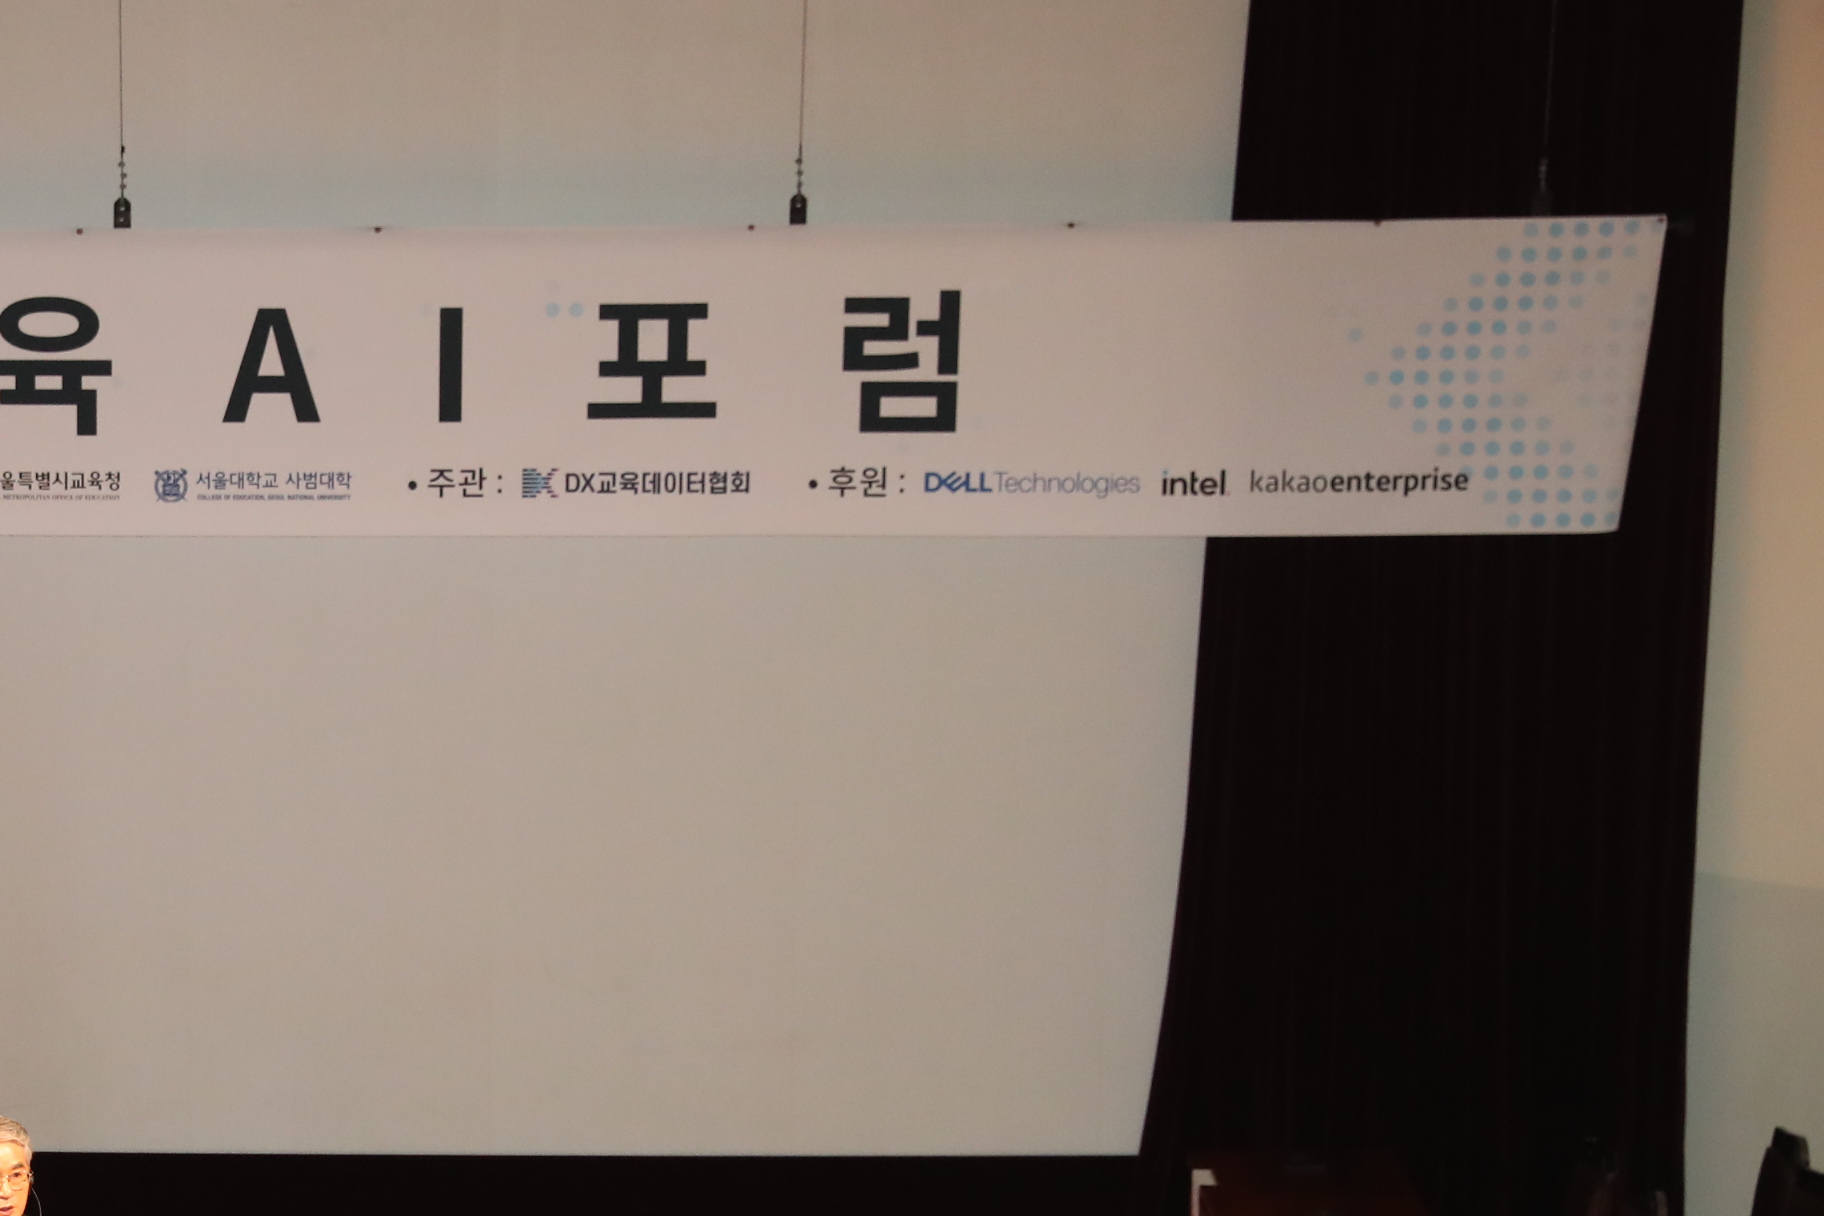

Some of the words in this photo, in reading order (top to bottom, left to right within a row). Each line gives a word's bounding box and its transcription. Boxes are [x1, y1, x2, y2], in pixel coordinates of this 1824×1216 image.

[195, 471, 279, 491] 서울대학교
[285, 471, 352, 491] 사범대학
[565, 471, 751, 495] DX교육데이터협회
